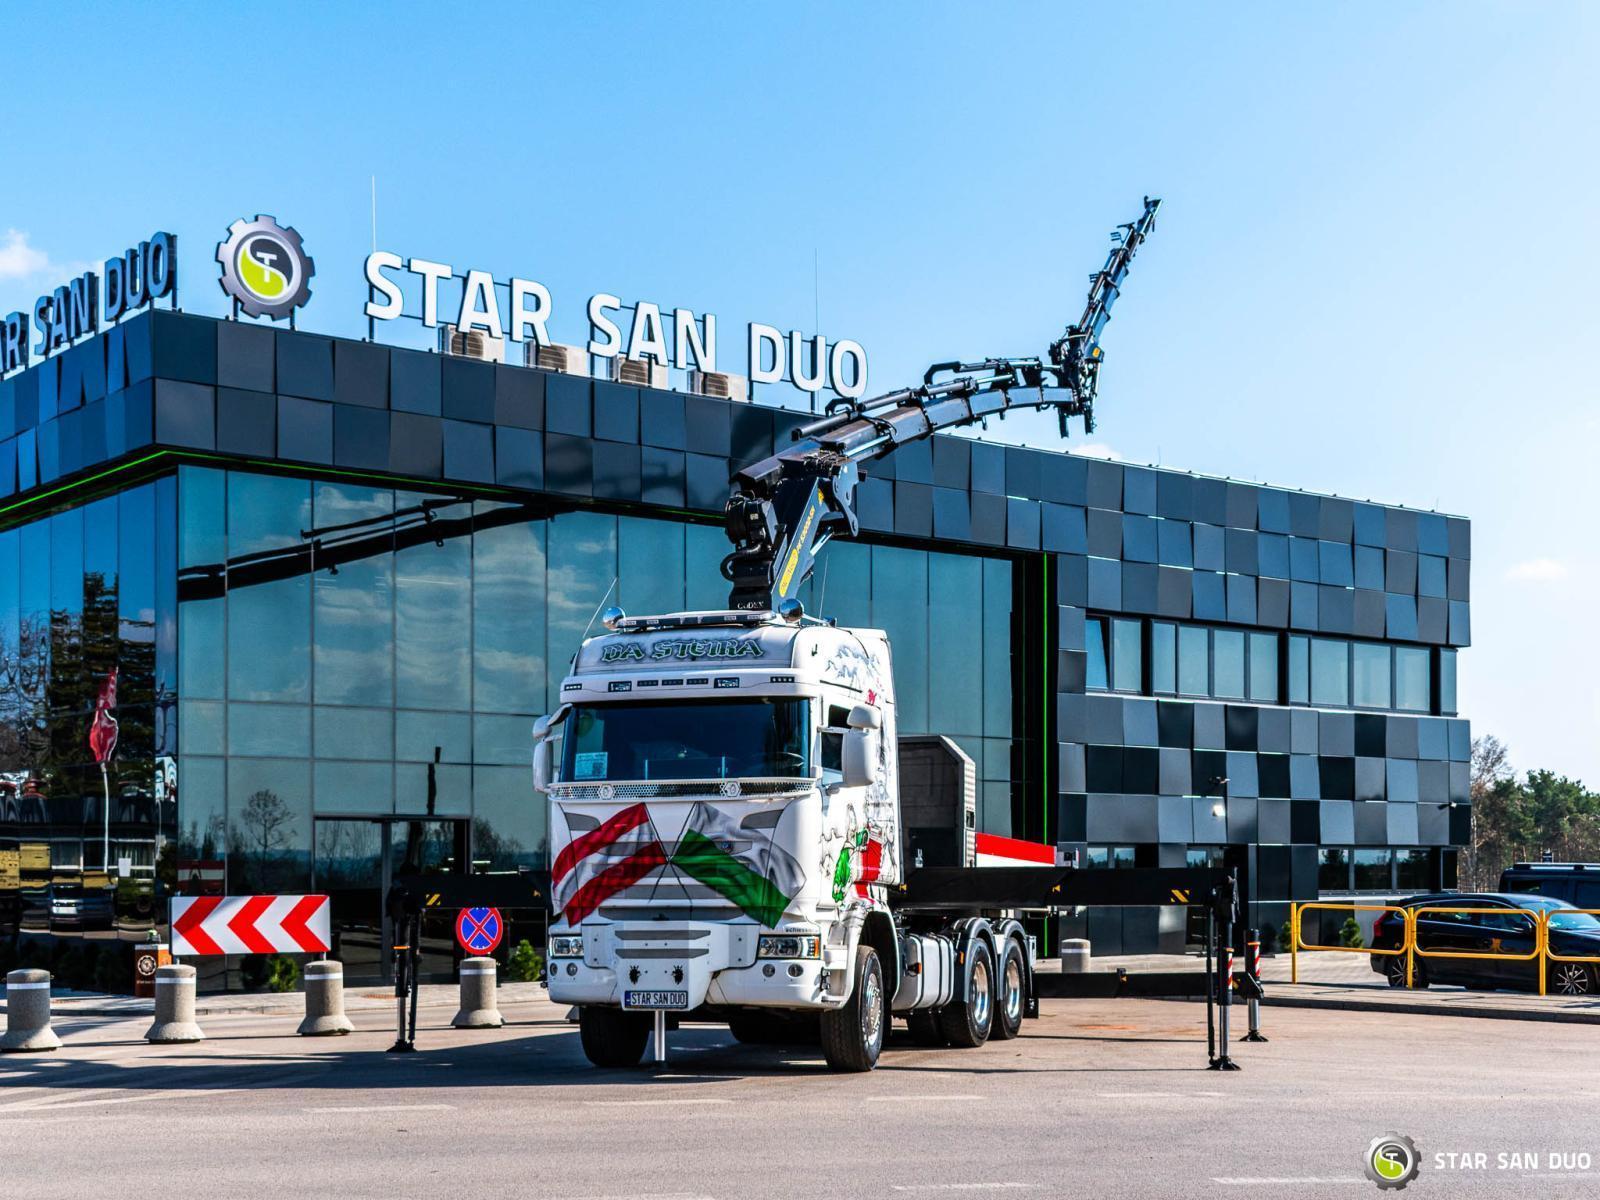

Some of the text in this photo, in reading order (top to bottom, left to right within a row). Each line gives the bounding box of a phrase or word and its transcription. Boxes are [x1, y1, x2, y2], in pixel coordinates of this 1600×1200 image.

[34, 272, 98, 355] SAN
[105, 231, 174, 321] DUO
[365, 251, 869, 398] STAR SAN DUO
[601, 643, 646, 663] DA
[631, 992, 686, 1005] STAR SAN DUO
